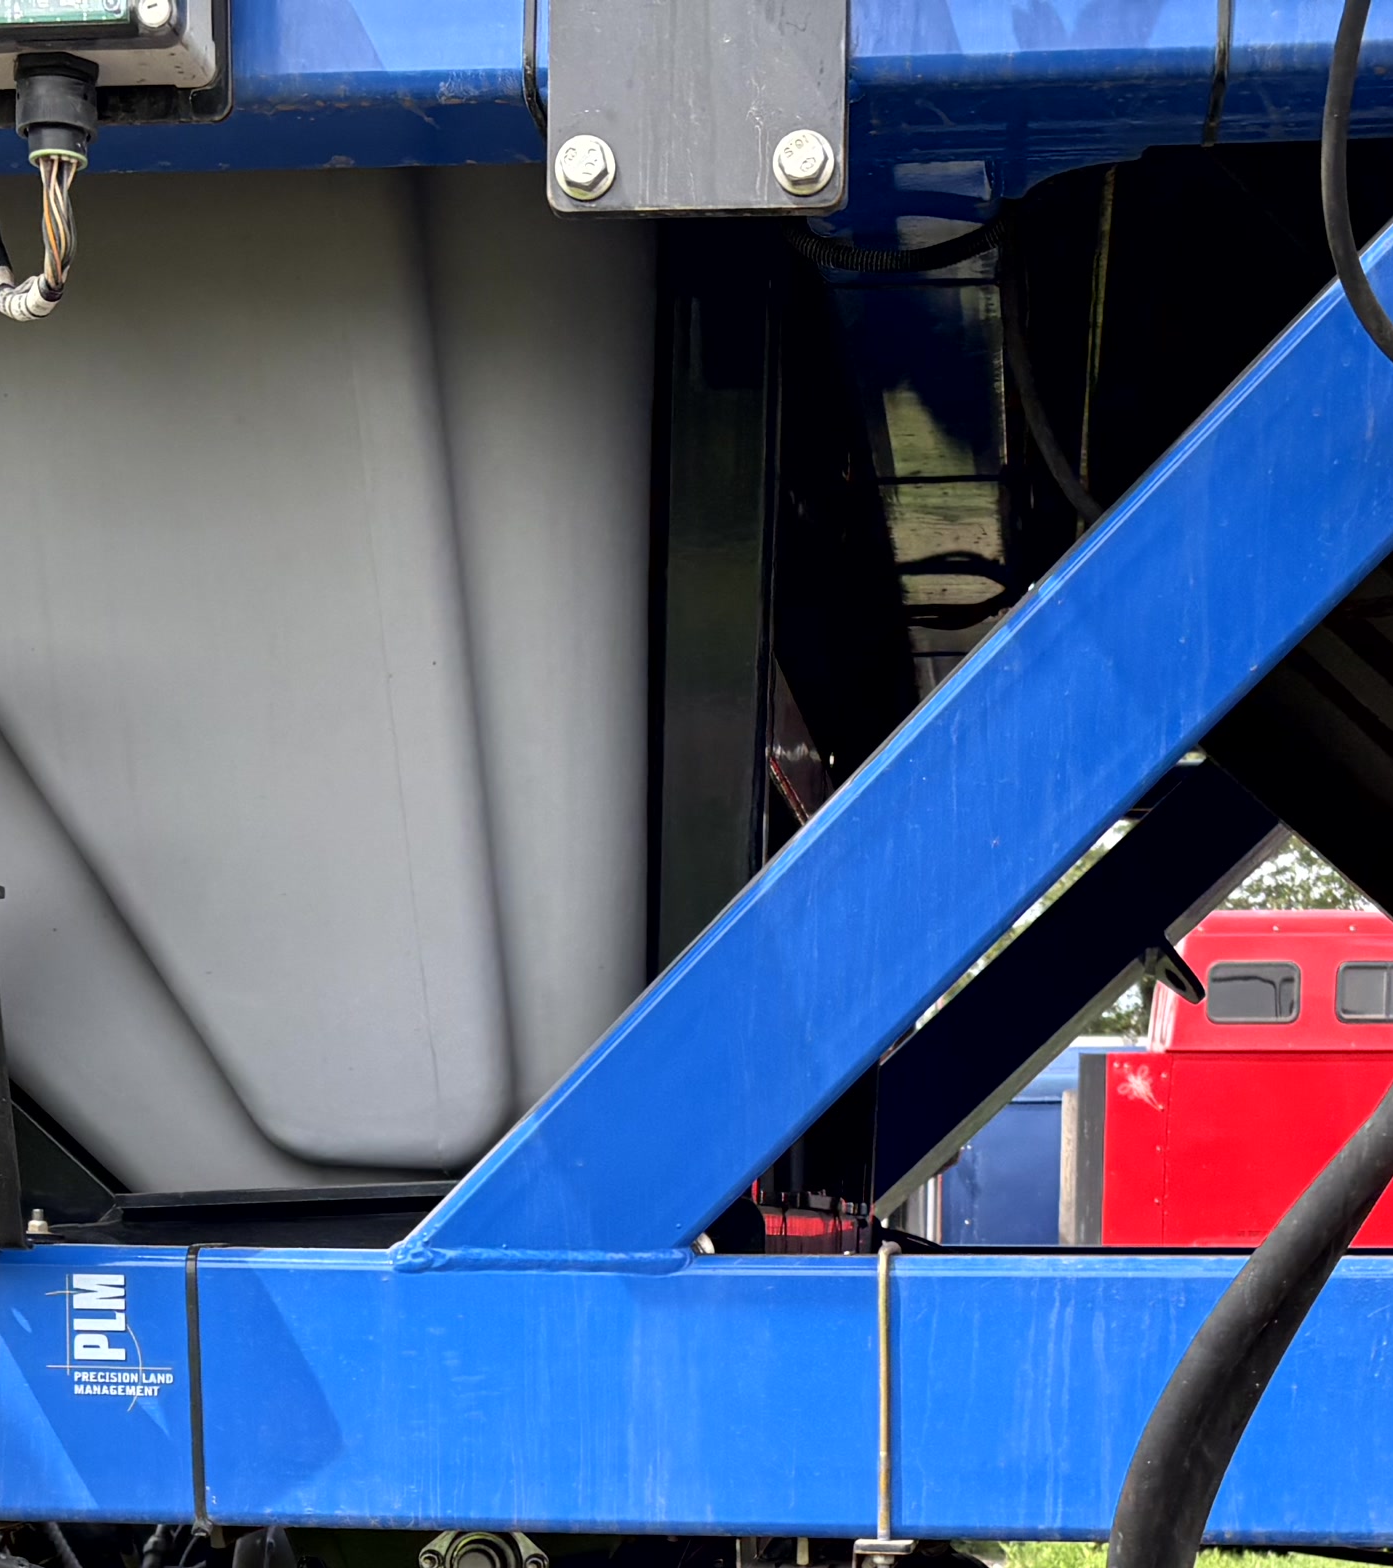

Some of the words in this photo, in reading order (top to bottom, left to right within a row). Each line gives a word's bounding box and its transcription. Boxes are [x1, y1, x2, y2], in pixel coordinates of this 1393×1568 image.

[72, 1273, 126, 1361] PLM
[73, 1370, 139, 1383] PRECISION
[142, 1372, 174, 1384] LAND
[73, 1383, 161, 1397] MANAGEMENT
